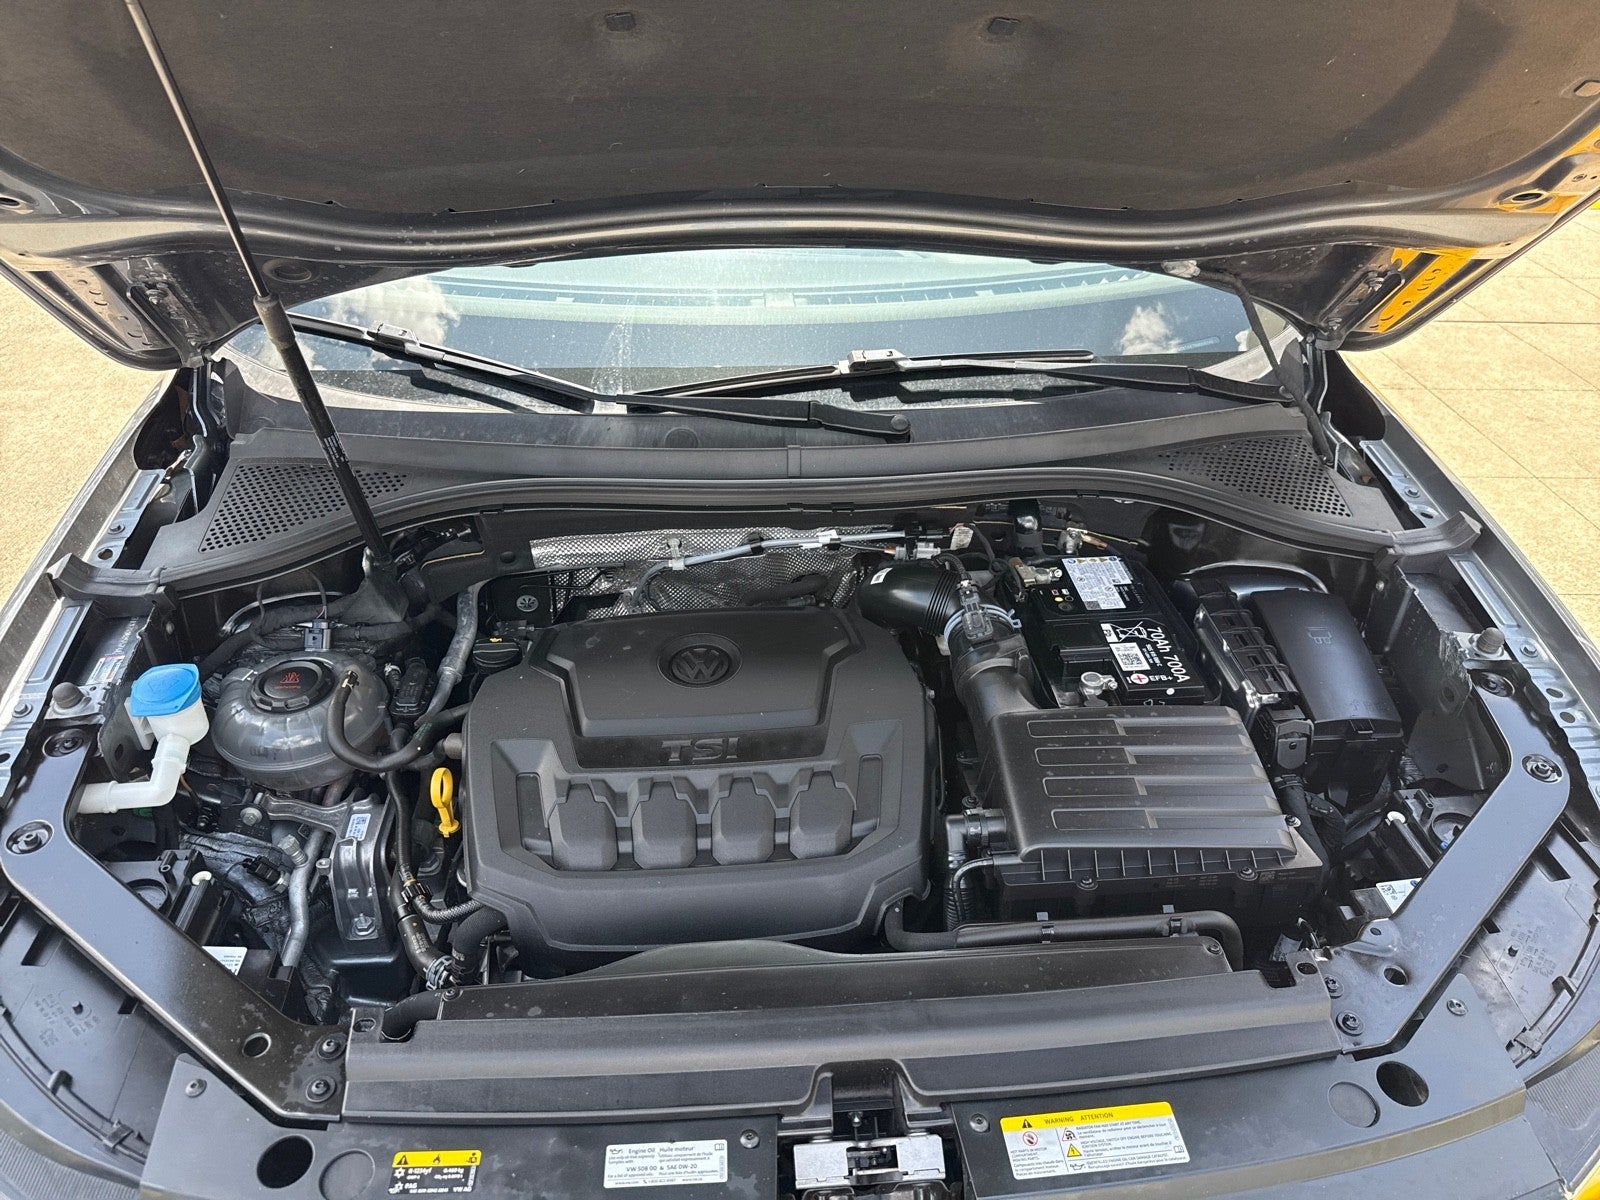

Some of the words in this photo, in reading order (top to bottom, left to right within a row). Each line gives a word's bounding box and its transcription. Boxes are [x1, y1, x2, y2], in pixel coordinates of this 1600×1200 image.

[1147, 626, 1172, 653] 70Ah
[1163, 654, 1191, 683] 700A
[661, 737, 739, 762] TSI
[1044, 1116, 1074, 1125] WARNING
[1080, 1112, 1114, 1121] ATTENTION
